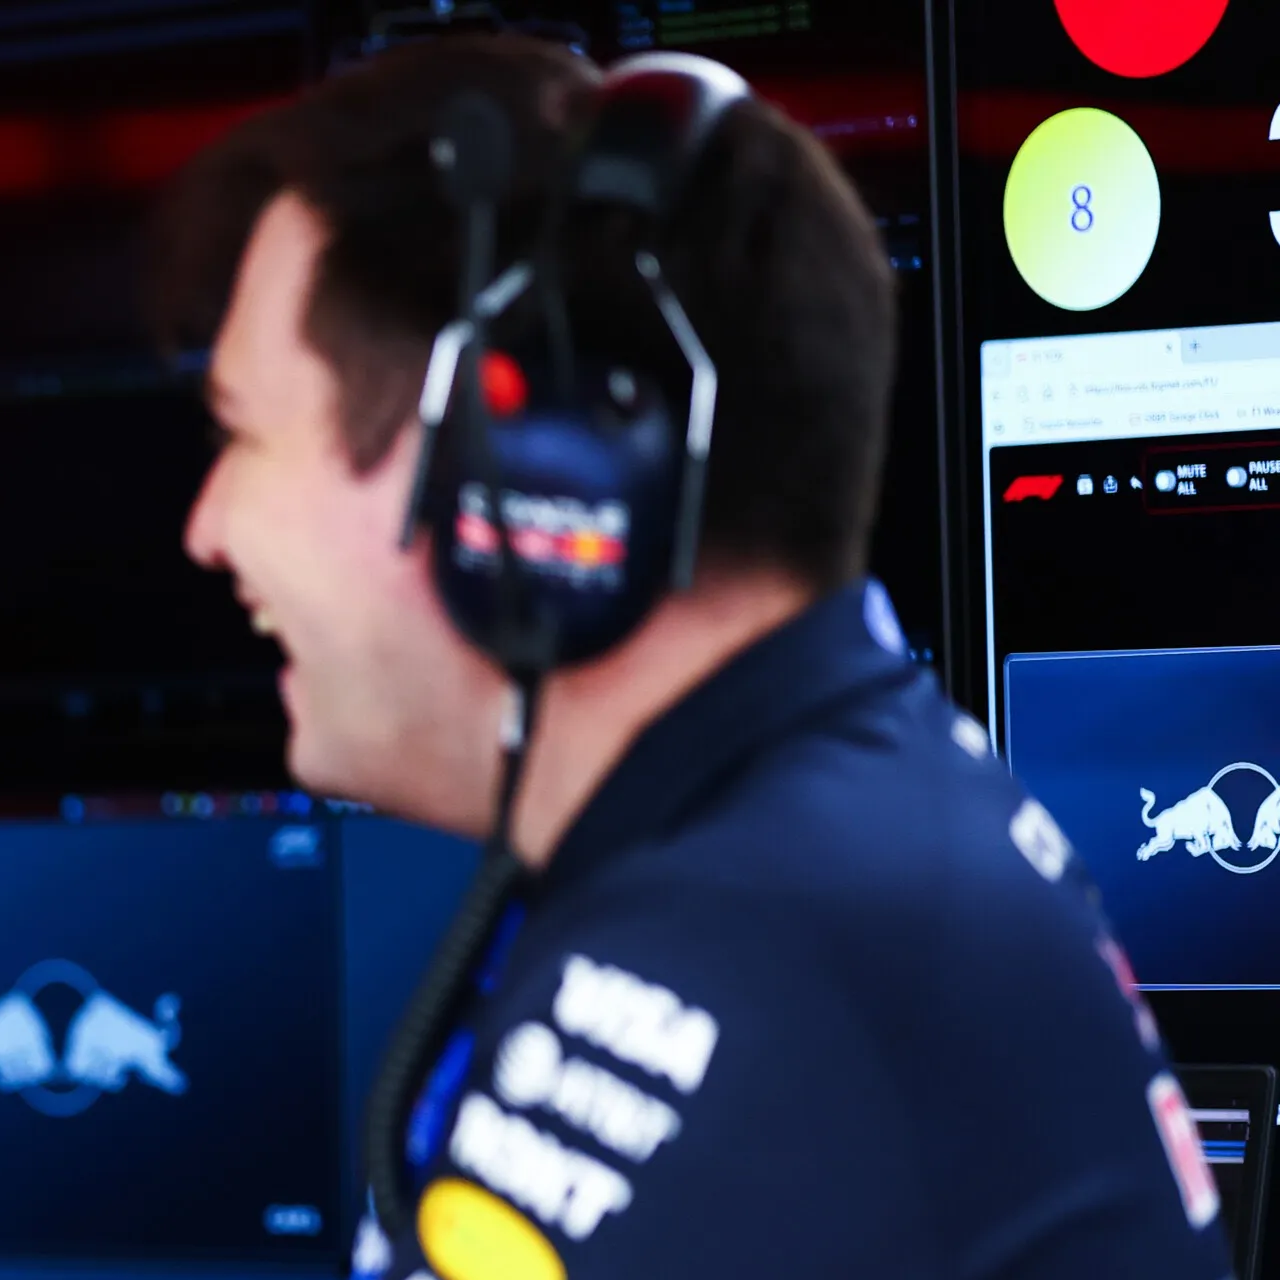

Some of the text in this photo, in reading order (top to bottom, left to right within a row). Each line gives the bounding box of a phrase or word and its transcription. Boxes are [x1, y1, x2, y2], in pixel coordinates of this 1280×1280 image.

[1070, 185, 1094, 232] 8
[1176, 463, 1207, 480] MUTE
[1177, 481, 1197, 496] ALL
[1248, 478, 1269, 492] ALL
